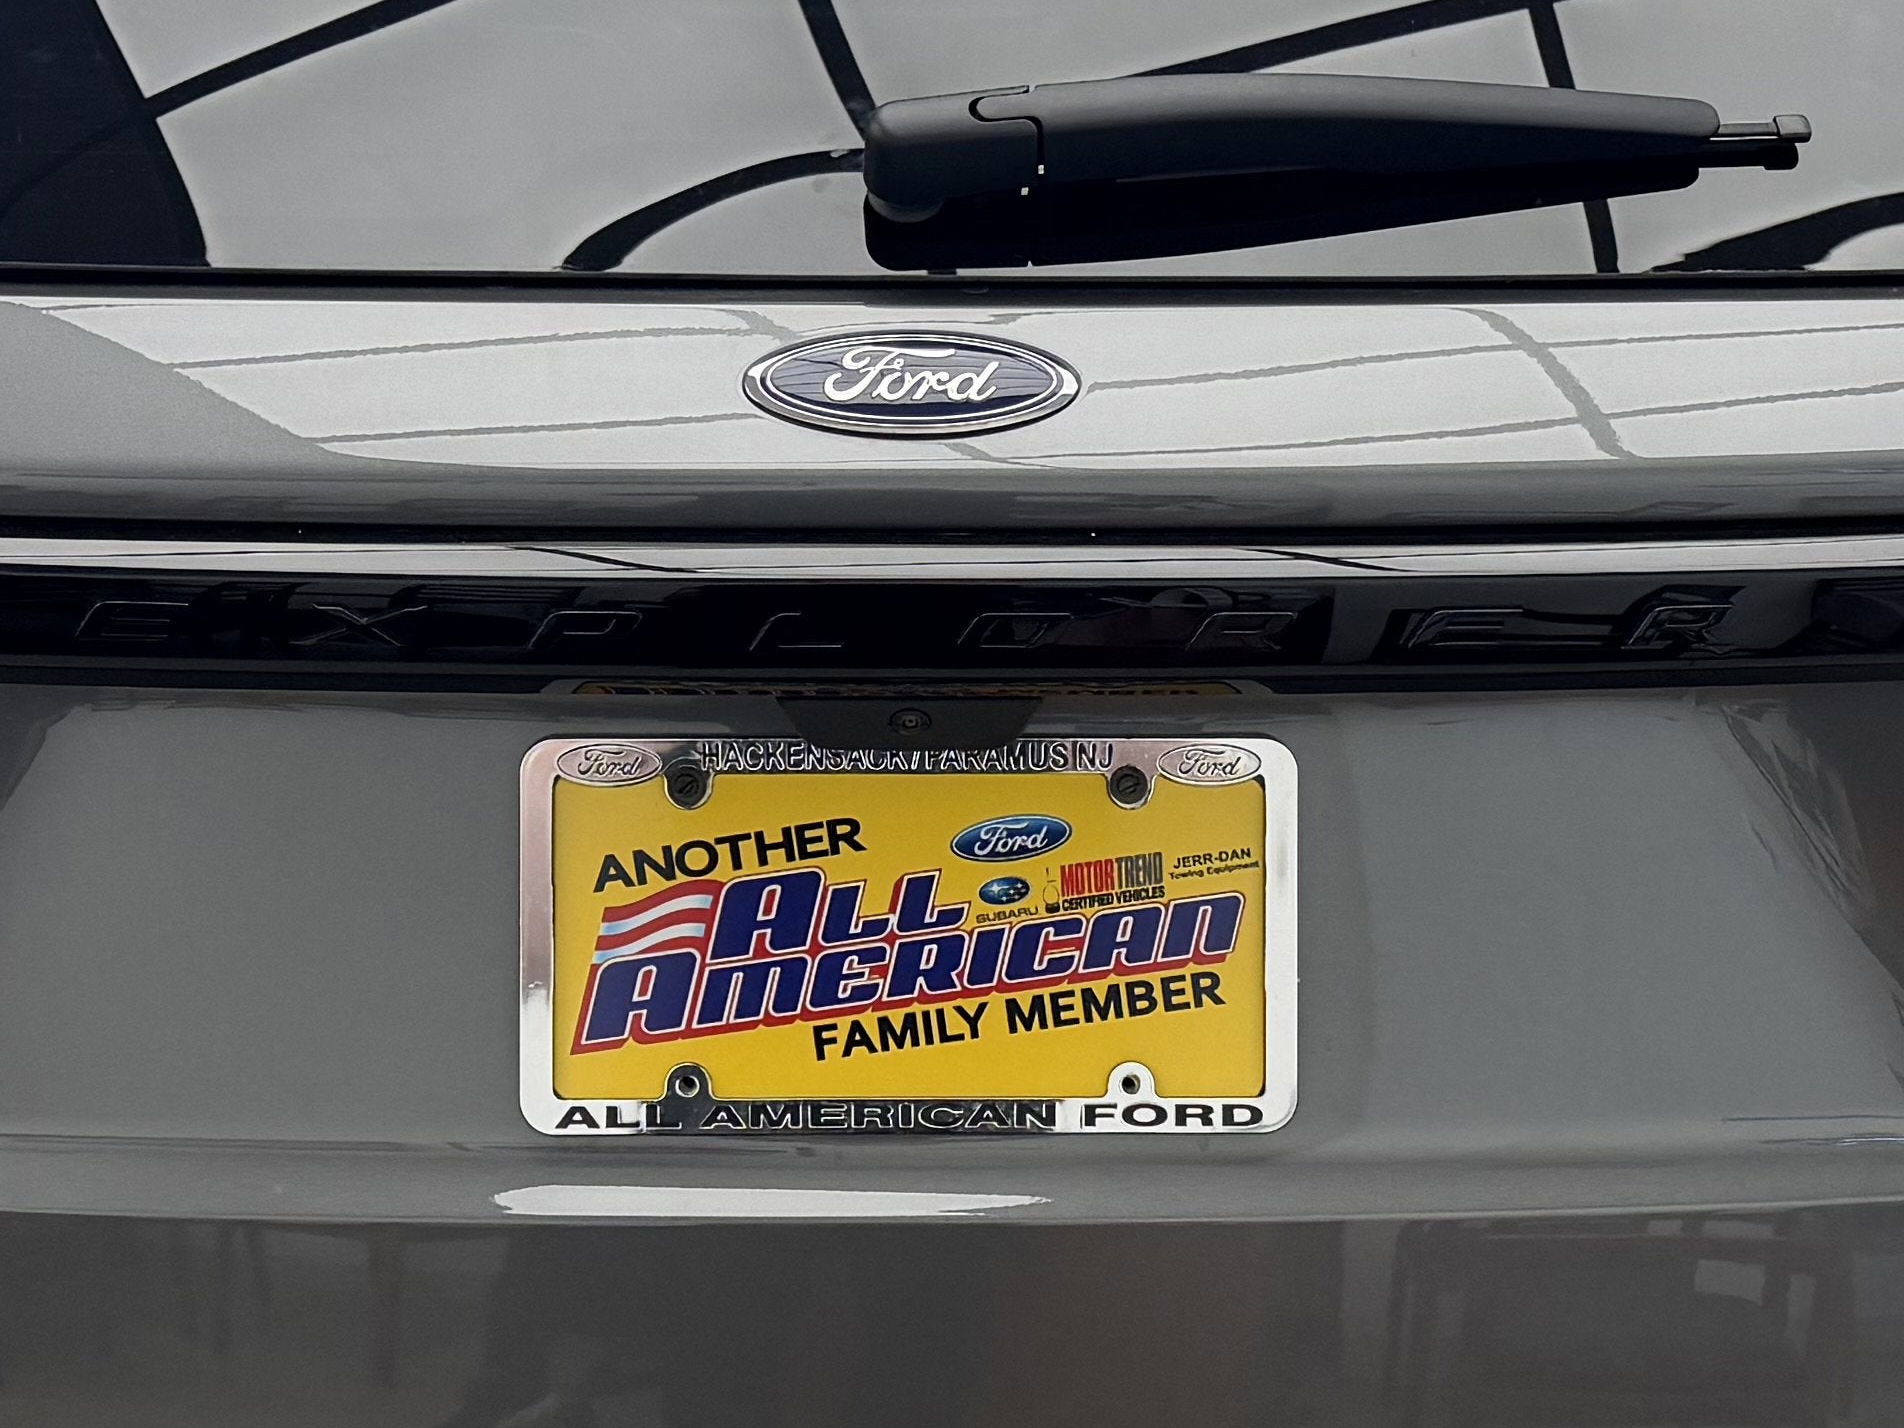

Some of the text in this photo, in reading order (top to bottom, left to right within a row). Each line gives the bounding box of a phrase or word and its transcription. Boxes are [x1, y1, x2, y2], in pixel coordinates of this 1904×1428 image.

[821, 345, 1000, 403] Ford
[73, 601, 1734, 652] EXPLORER
[577, 747, 643, 778] Ford
[1075, 740, 1114, 772] NJ
[1176, 747, 1242, 777] Ford
[972, 820, 1050, 857] Ford
[593, 817, 867, 893] ANOTHER
[1169, 860, 1260, 881] Towing Equipment
[1173, 847, 1252, 870] JERR-DAN
[1061, 885, 1166, 912] CERTIFIED VEHICLES
[976, 905, 1040, 924] SUBARU
[812, 971, 1227, 1062] FAMILY MEMBER
[554, 1102, 1264, 1131] ALL AMERICAN FORD
